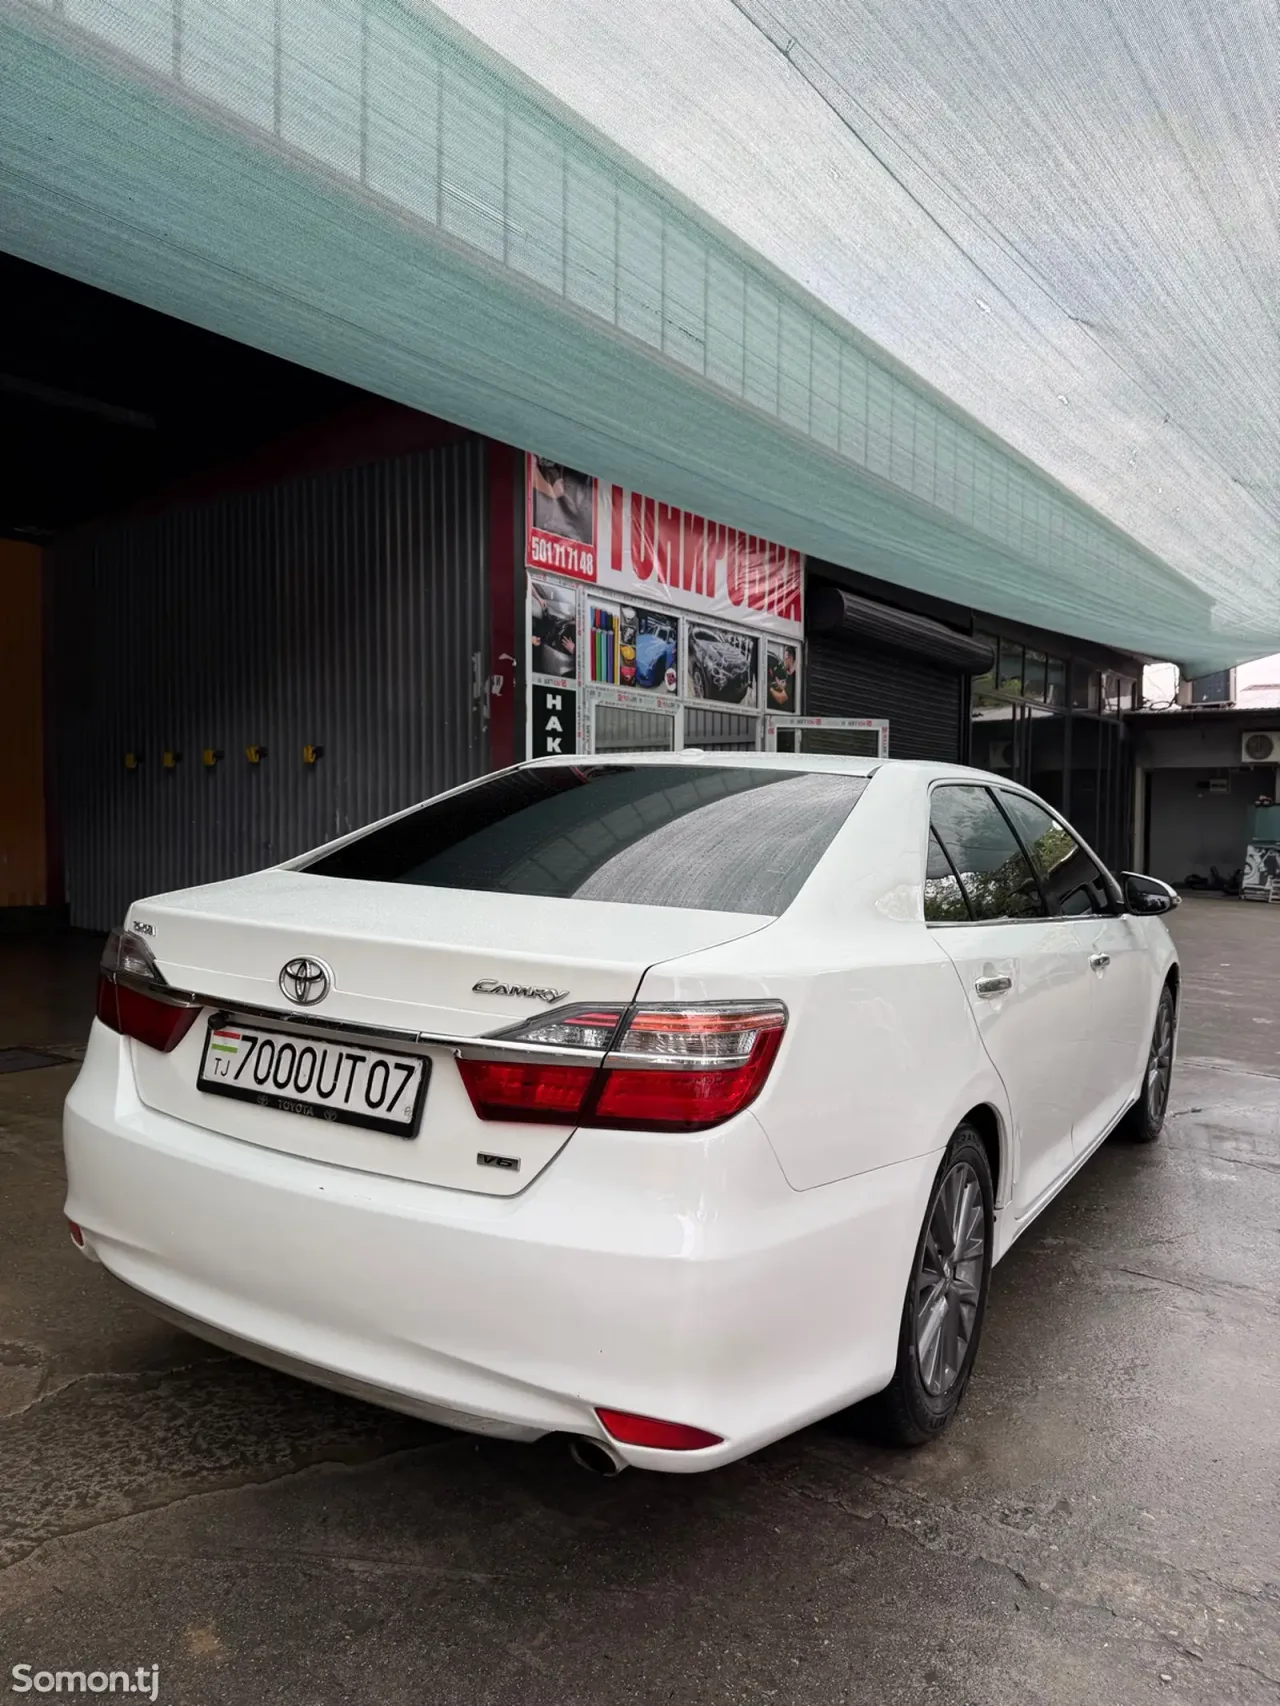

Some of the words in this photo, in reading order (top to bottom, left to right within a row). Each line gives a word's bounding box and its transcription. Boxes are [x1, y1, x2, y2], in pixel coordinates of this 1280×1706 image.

[213, 1057, 231, 1077] TJ
[278, 1099, 315, 1117] TOYOTA
[482, 1154, 513, 1168] V6
